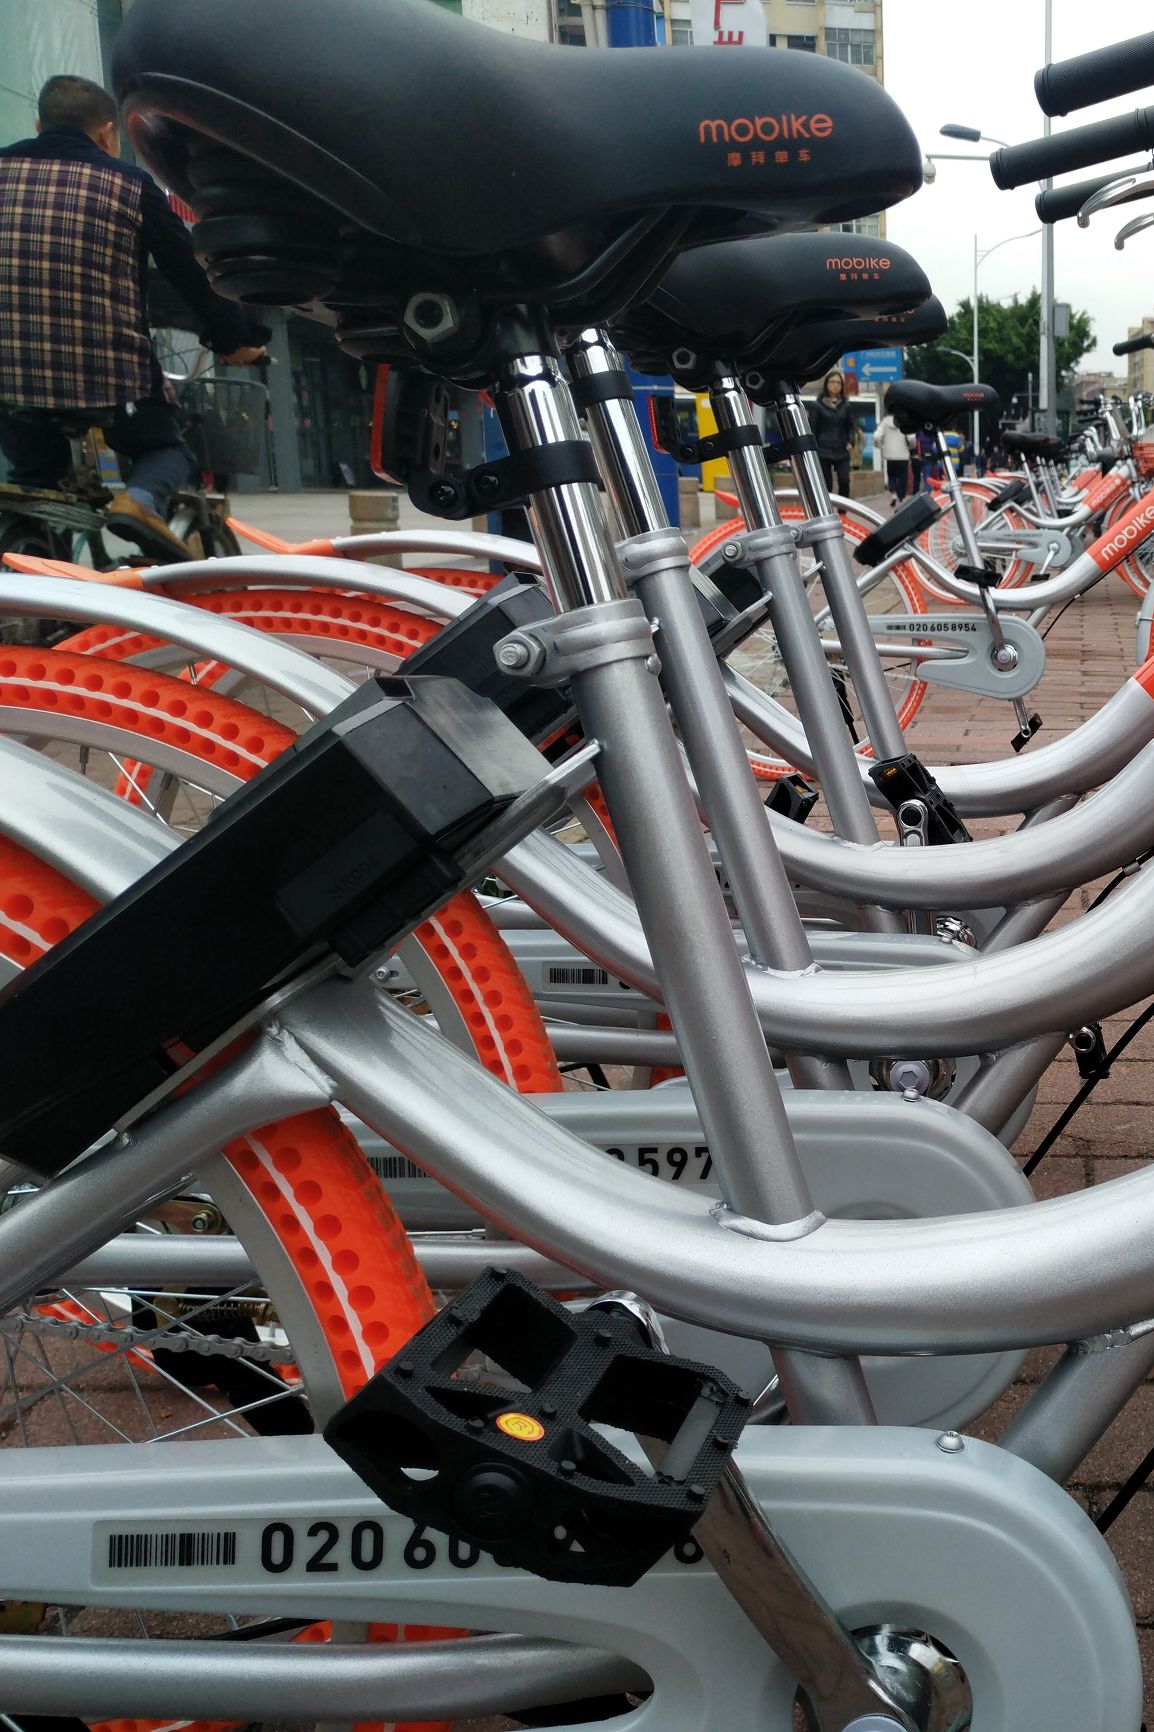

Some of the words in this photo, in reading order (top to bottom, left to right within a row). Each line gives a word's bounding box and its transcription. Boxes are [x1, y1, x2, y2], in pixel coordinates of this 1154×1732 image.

[699, 113, 833, 144] mobike
[826, 257, 891, 270] mobike
[909, 623, 928, 632] 020
[930, 623, 949, 632] 605
[951, 622, 977, 632] 8954
[261, 1520, 384, 1574] 020
[403, 1522, 515, 1570] 60
